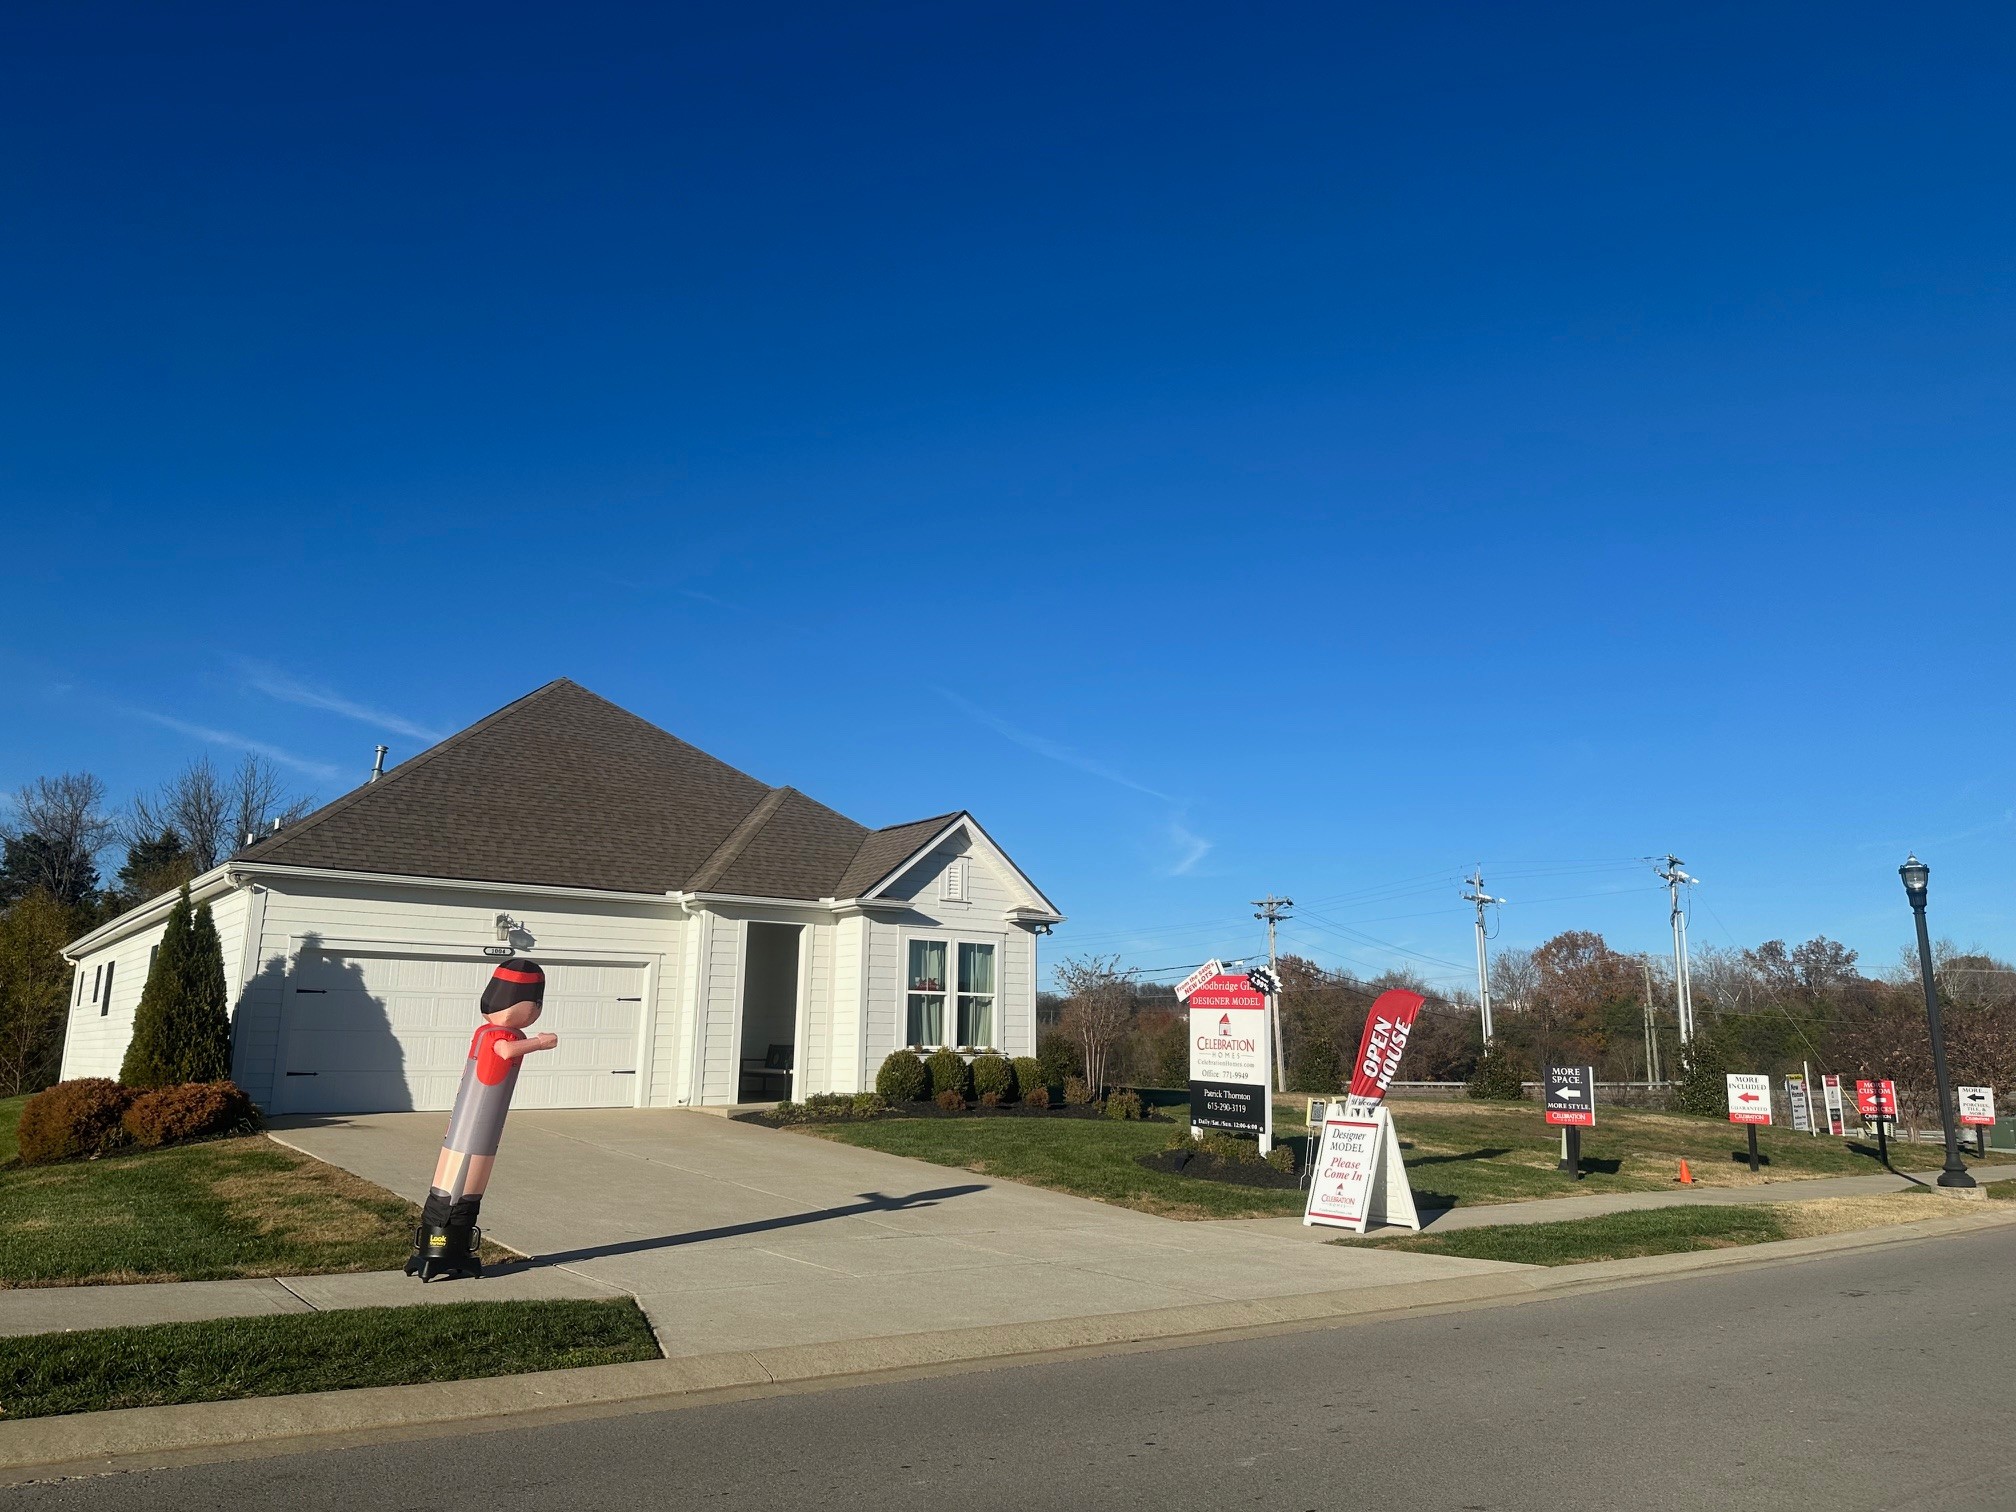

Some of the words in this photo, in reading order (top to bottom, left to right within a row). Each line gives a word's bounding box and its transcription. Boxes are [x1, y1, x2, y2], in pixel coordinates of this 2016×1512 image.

[1184, 983, 1198, 995] NEW
[1199, 971, 1213, 985] LOTS
[1198, 981, 1239, 992] oodbridge
[1192, 997, 1231, 1006] DESIGNER
[1231, 997, 1261, 1006] MODEL
[1197, 1036, 1255, 1052] CELEBRATION
[1362, 1015, 1393, 1078] OPEN
[1211, 1052, 1241, 1060] HOMES
[1375, 1016, 1412, 1091] HOUSE
[1552, 1067, 1580, 1076] MORE
[1552, 1076, 1583, 1084] SPACE.
[1203, 1088, 1223, 1098] Patrick
[1223, 1090, 1251, 1101] Thornton
[1332, 1128, 1367, 1142] Designer
[1330, 1142, 1365, 1153] MODEL
[1330, 1157, 1361, 1169] Please
[1324, 1168, 1350, 1180] Come
[1351, 1170, 1363, 1182] In
[430, 1234, 447, 1242] Look
